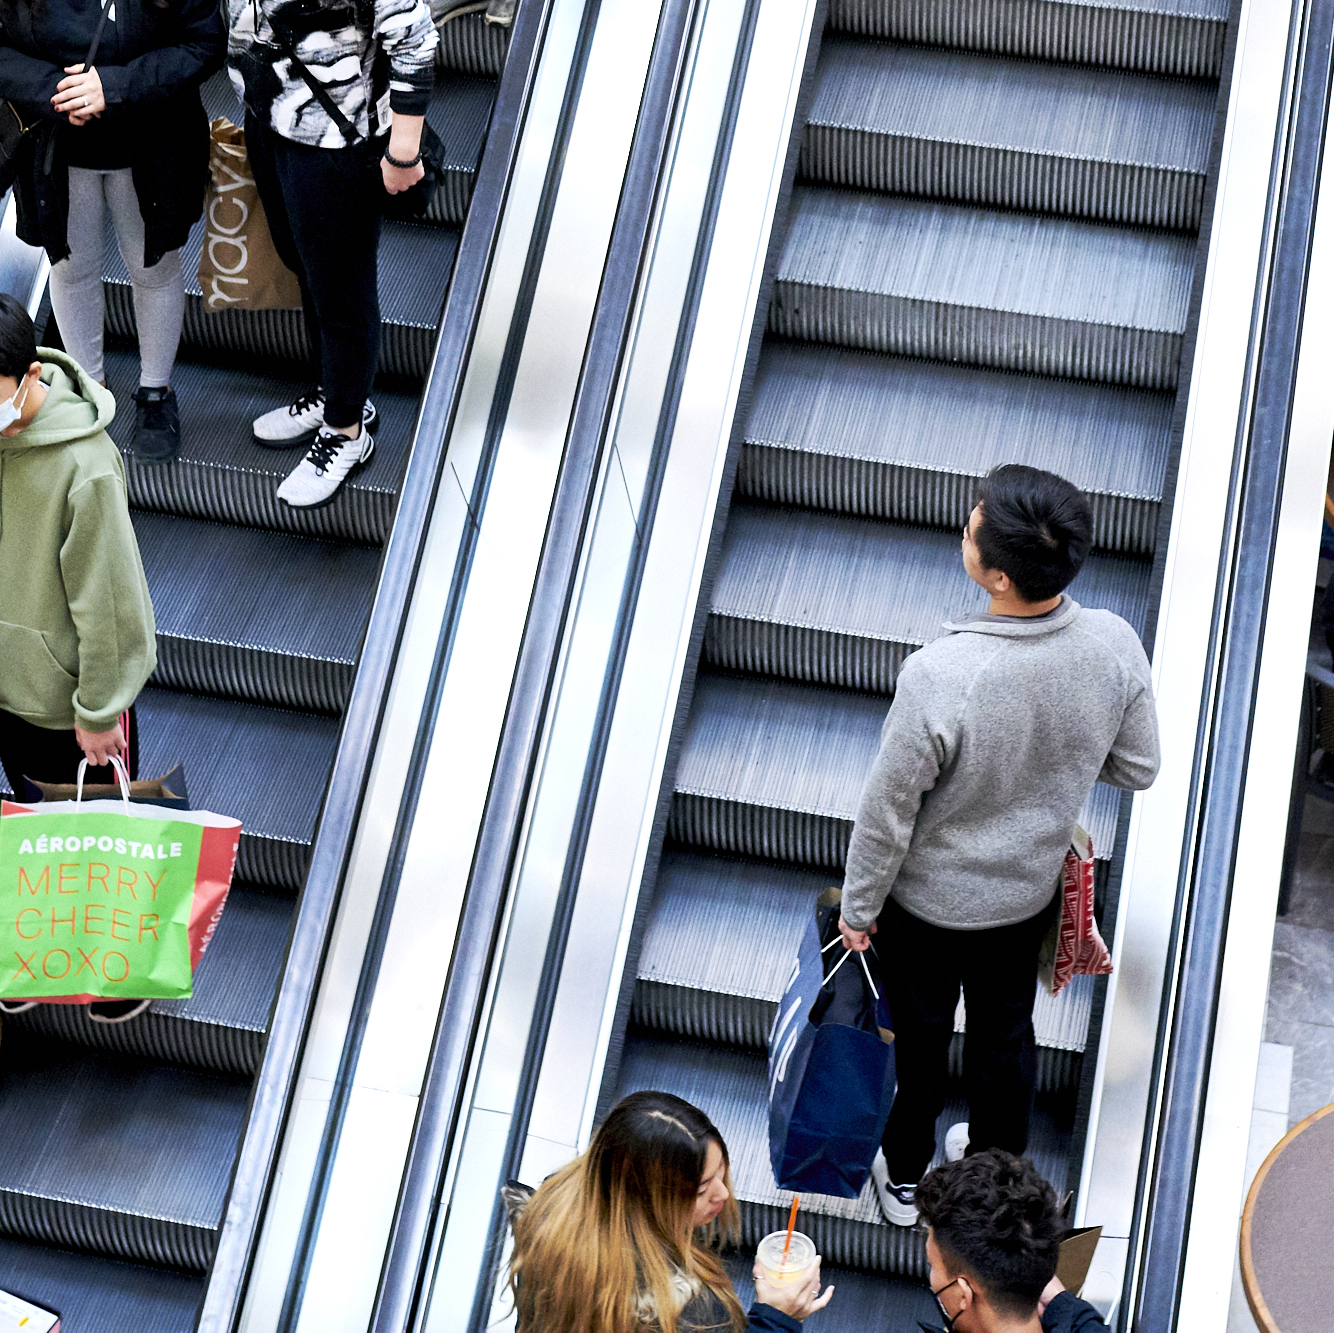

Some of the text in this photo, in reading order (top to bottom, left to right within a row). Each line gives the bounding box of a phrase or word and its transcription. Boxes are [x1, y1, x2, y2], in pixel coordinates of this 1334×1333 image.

[207, 156, 257, 309] macy
[18, 833, 183, 860] AÉROPOSTALE
[17, 862, 168, 901] MERRY
[15, 903, 161, 944] CHEER
[12, 946, 130, 983] XOXO
